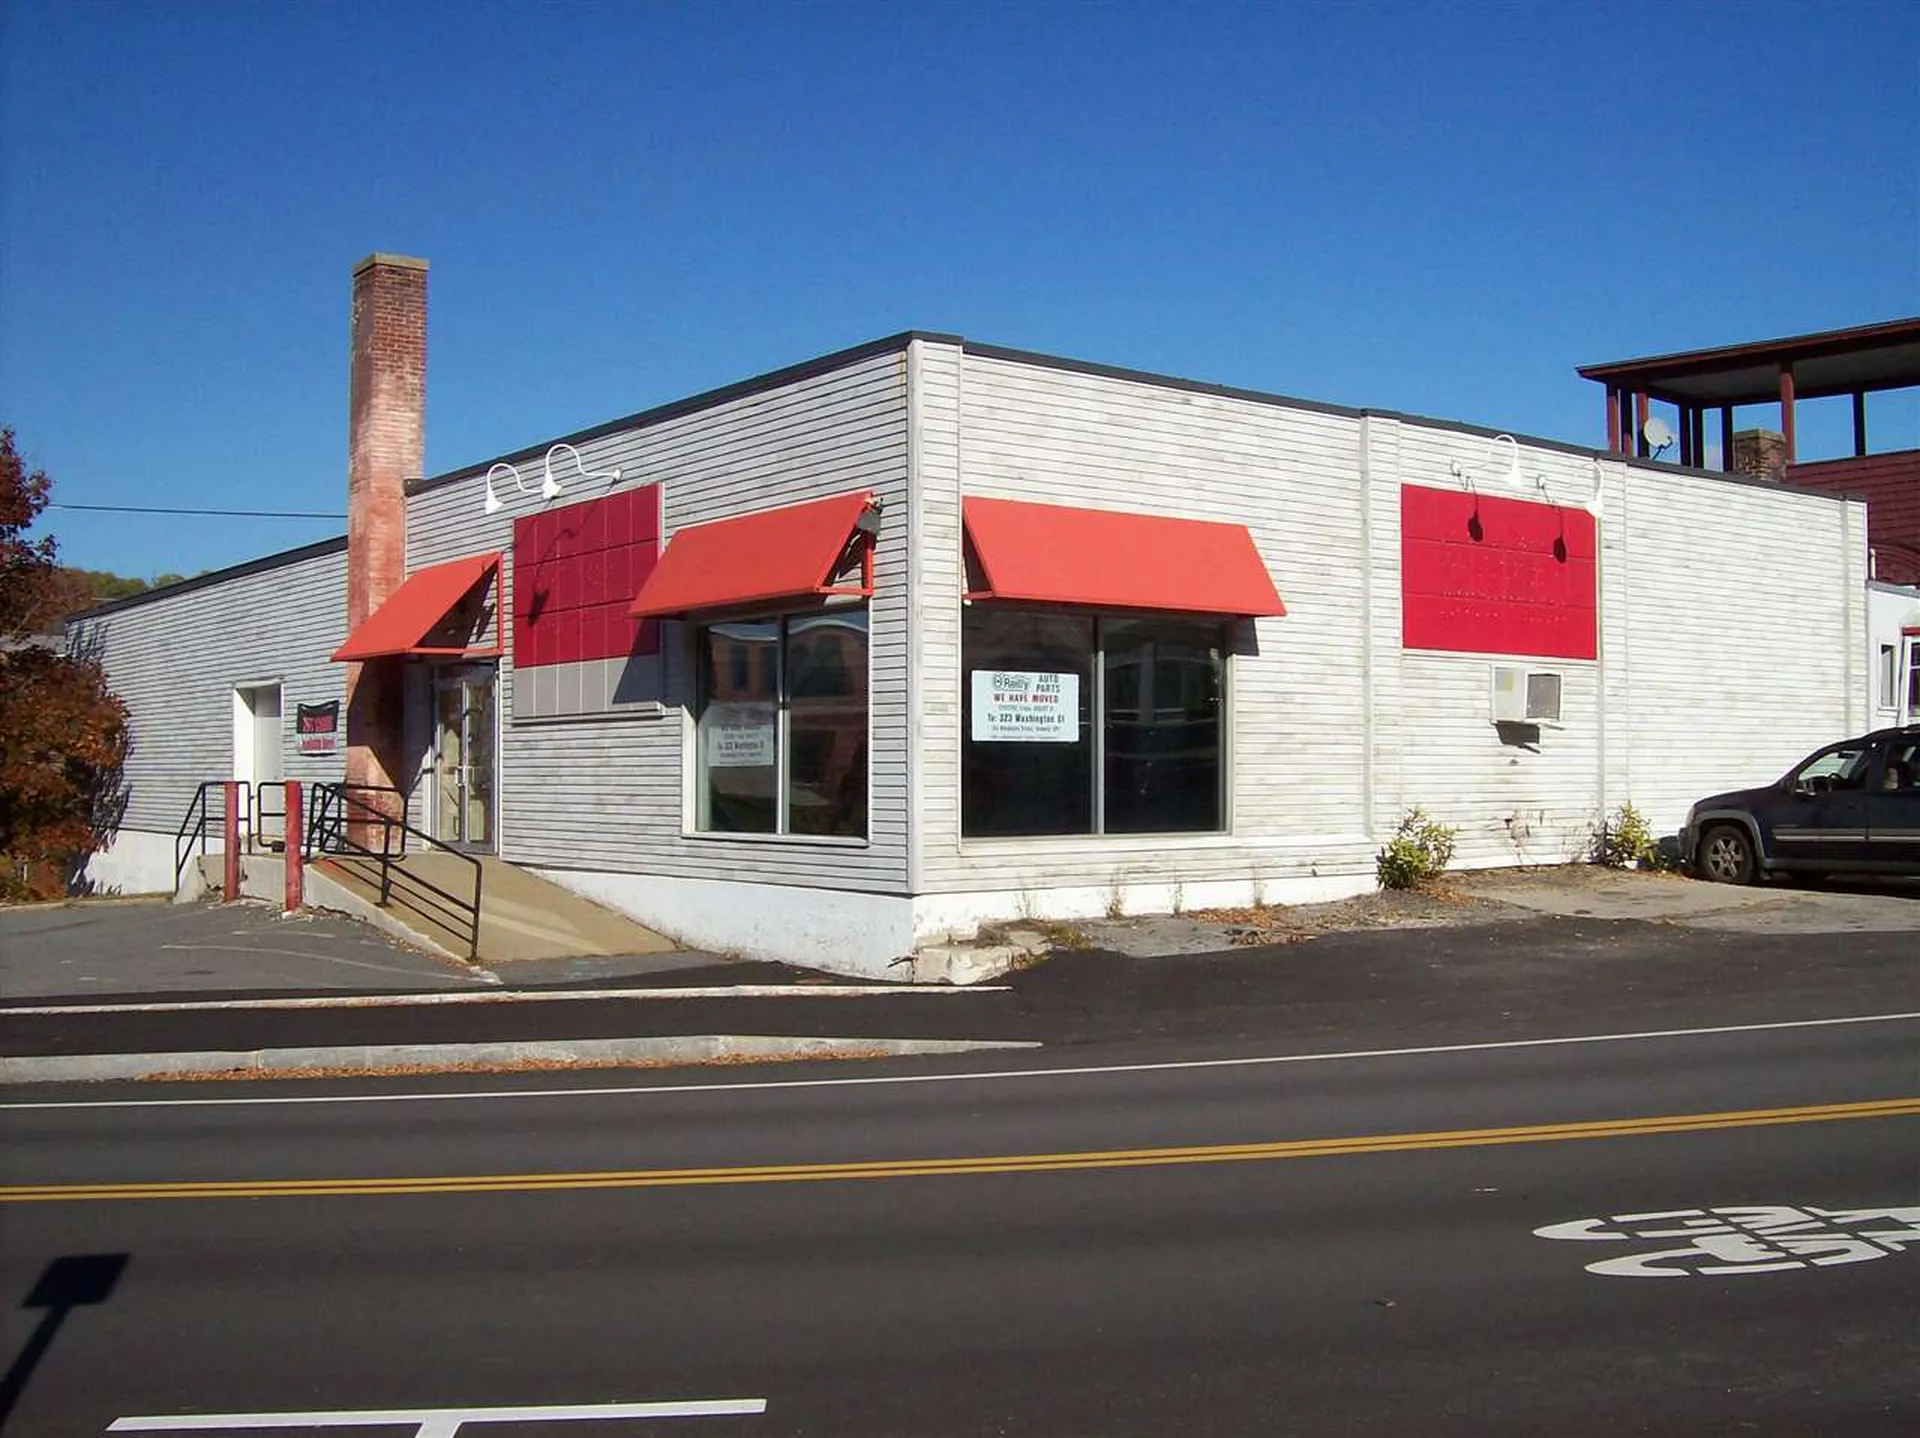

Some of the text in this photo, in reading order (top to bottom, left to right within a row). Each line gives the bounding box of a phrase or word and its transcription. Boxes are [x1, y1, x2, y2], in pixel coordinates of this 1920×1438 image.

[1039, 674, 1059, 683] AUTO
[1036, 683, 1060, 693] PARTS
[994, 694, 1059, 703] WE HAVE MOVED
[1015, 713, 1055, 725] Washington
